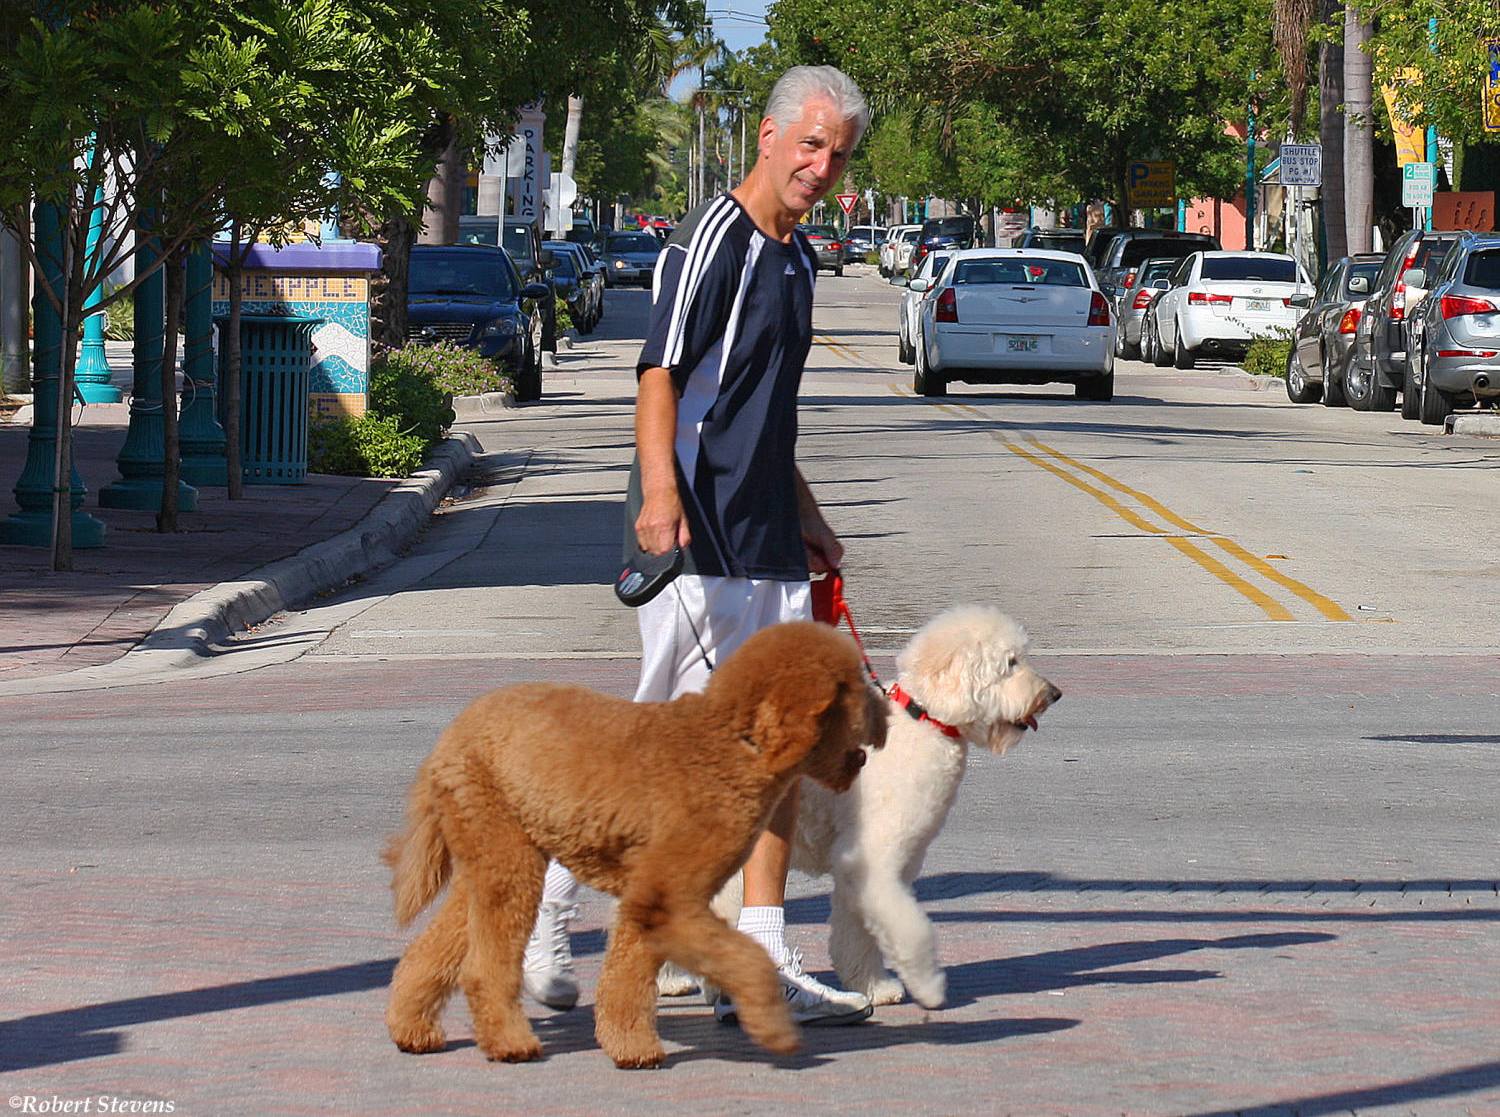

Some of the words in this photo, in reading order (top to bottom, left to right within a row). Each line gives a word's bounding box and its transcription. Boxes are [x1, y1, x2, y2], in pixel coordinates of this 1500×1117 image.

[1284, 147, 1317, 156] SHUTTLE
[1282, 156, 1297, 165] BUS
[1299, 157, 1319, 166] STOP
[521, 129, 535, 217] PARKING
[1406, 166, 1413, 178] 2
